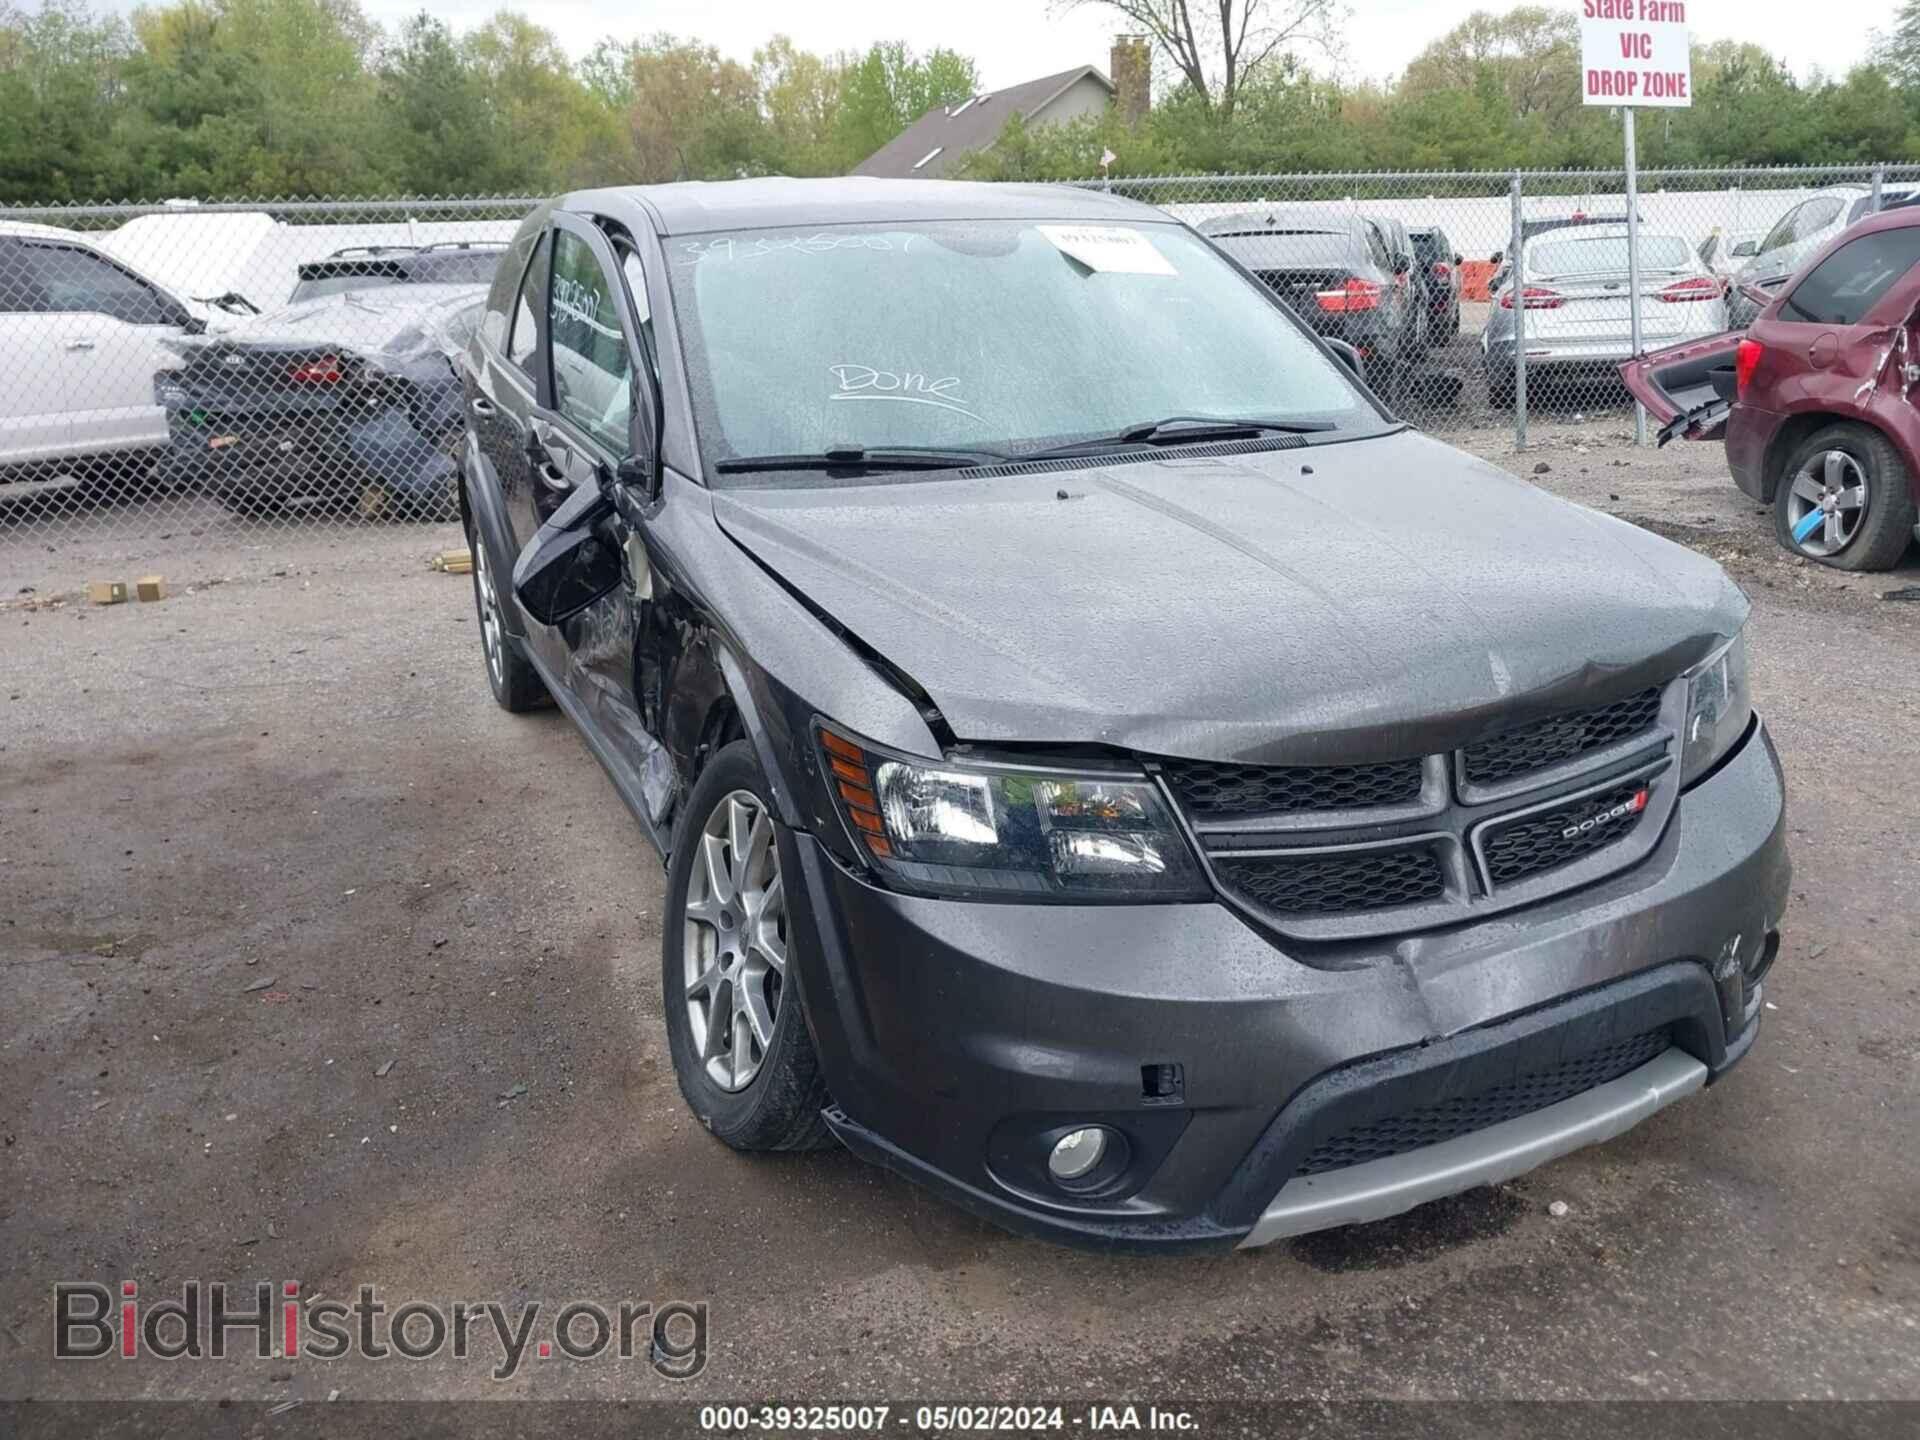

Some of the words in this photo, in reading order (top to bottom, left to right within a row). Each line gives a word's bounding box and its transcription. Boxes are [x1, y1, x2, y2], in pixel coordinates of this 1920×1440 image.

[1584, 0, 1634, 20] State
[1639, 0, 1685, 23] Farm
[1619, 32, 1652, 59] VIC
[1587, 70, 1638, 96] DROP
[1642, 71, 1687, 97] ZONE
[829, 364, 968, 404] Done
[1562, 799, 1637, 838] DODGE
